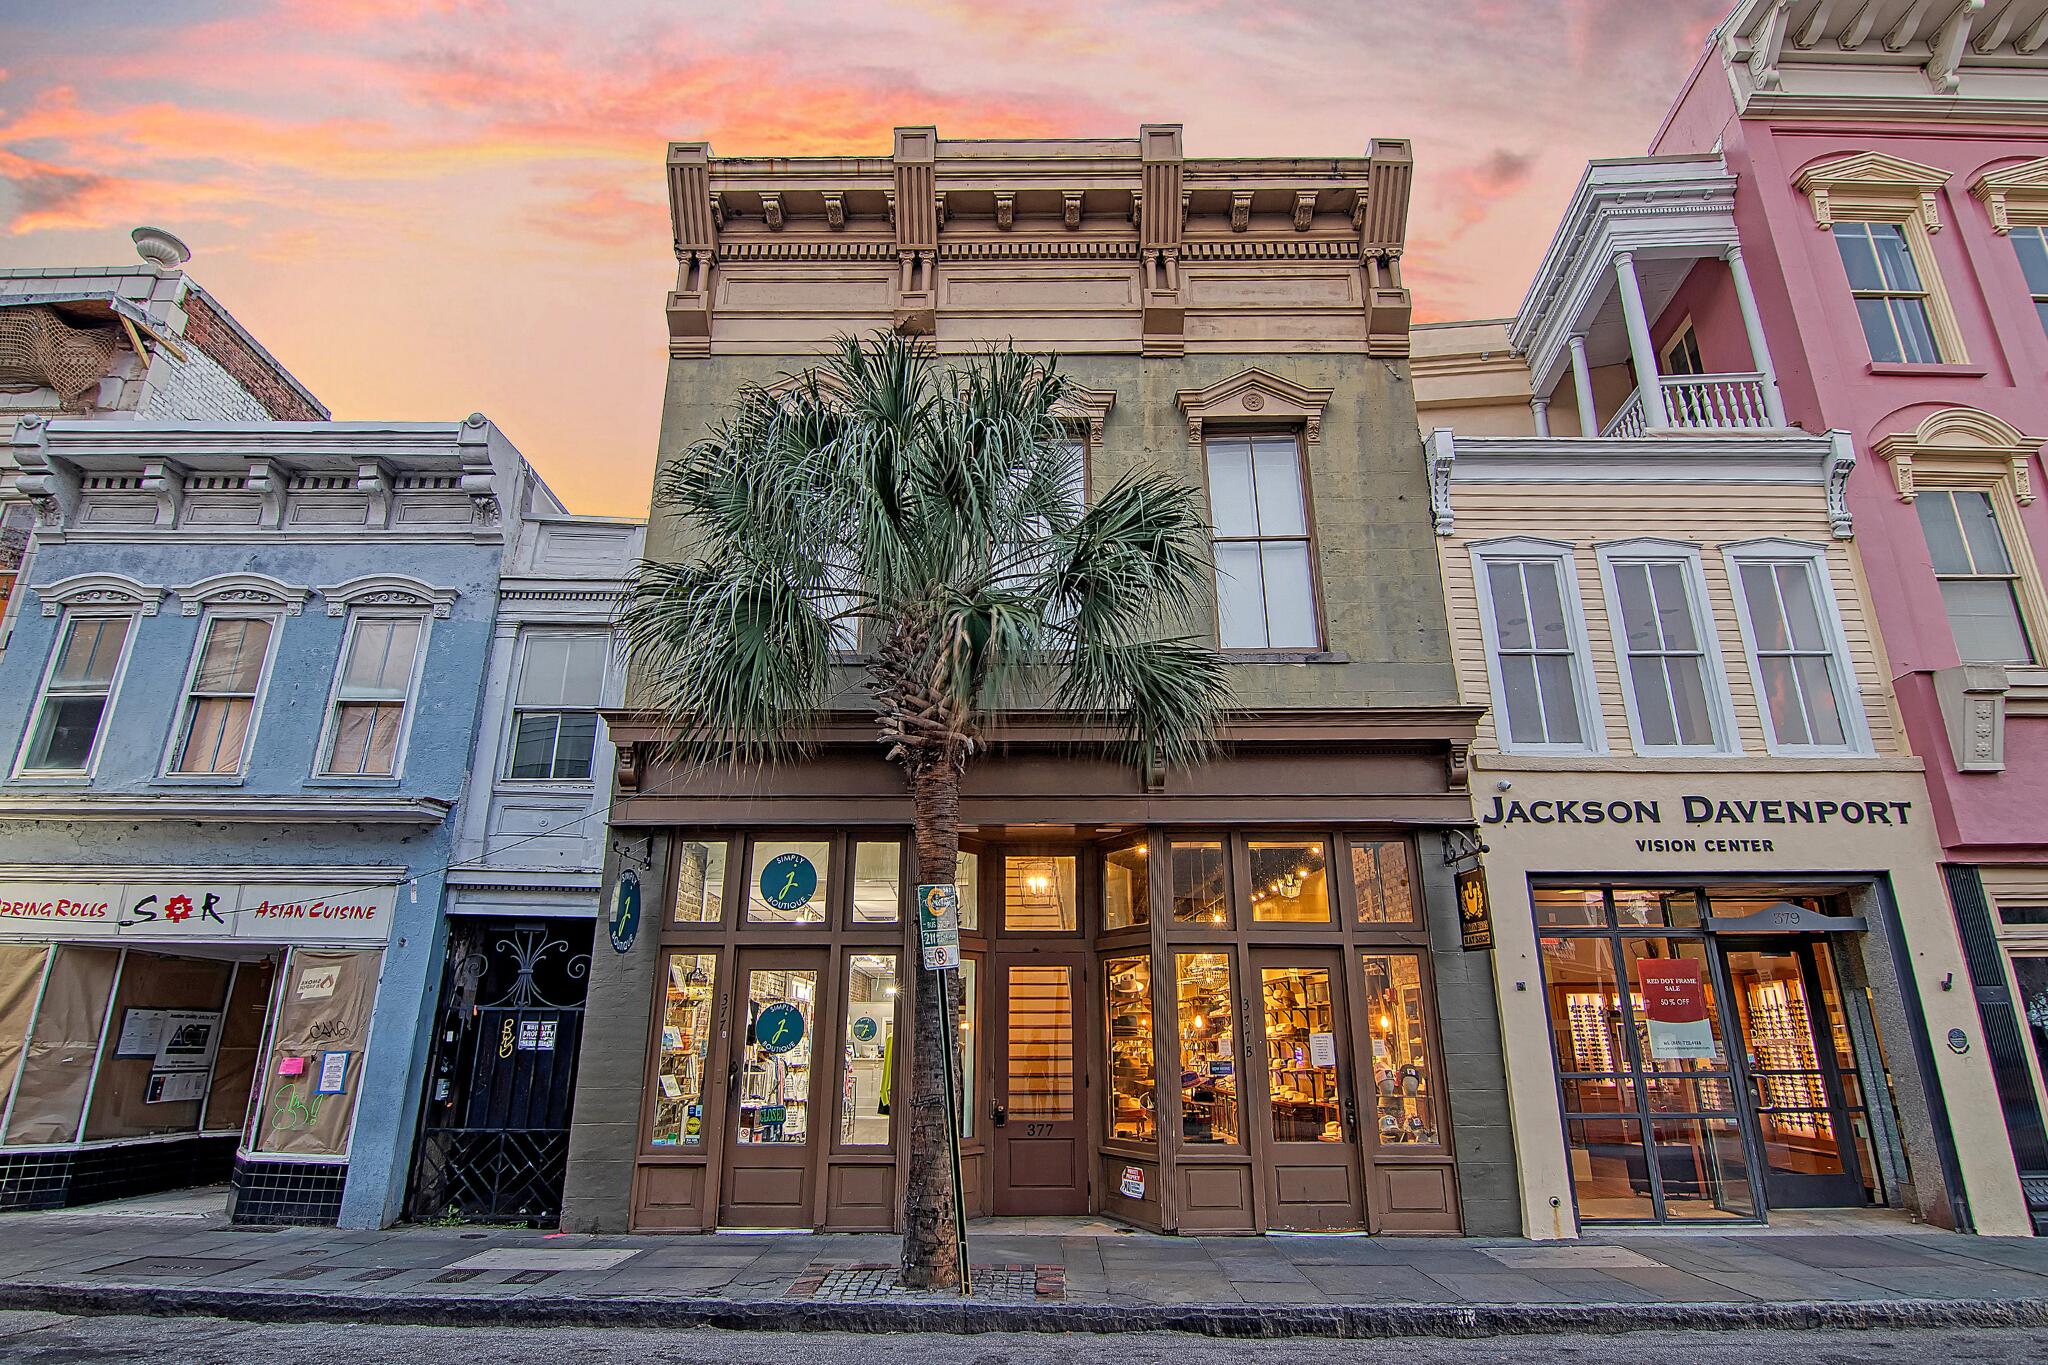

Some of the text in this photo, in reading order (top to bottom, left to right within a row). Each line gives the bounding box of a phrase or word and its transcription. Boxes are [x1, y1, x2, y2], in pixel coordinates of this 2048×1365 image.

[1483, 795, 1912, 825] JACKSON DAVENPORT
[1635, 839, 1774, 852] VISION CENTER
[776, 854, 806, 864] SIMPLY
[0, 898, 109, 917] PRING ROLLS
[767, 895, 807, 909] BOUTIQUE
[254, 901, 377, 919] ASIAN CUISINE
[927, 921, 937, 929] BUS
[1773, 912, 1800, 925] 379
[924, 932, 936, 945] 211
[770, 1003, 795, 1013] SIMPLY
[1677, 998, 1690, 1006] OFF
[167, 1023, 213, 1048] ACT
[761, 1040, 796, 1053] BOUTIQUE
[760, 1107, 786, 1123] CLOSED
[1027, 1123, 1054, 1137] 377
